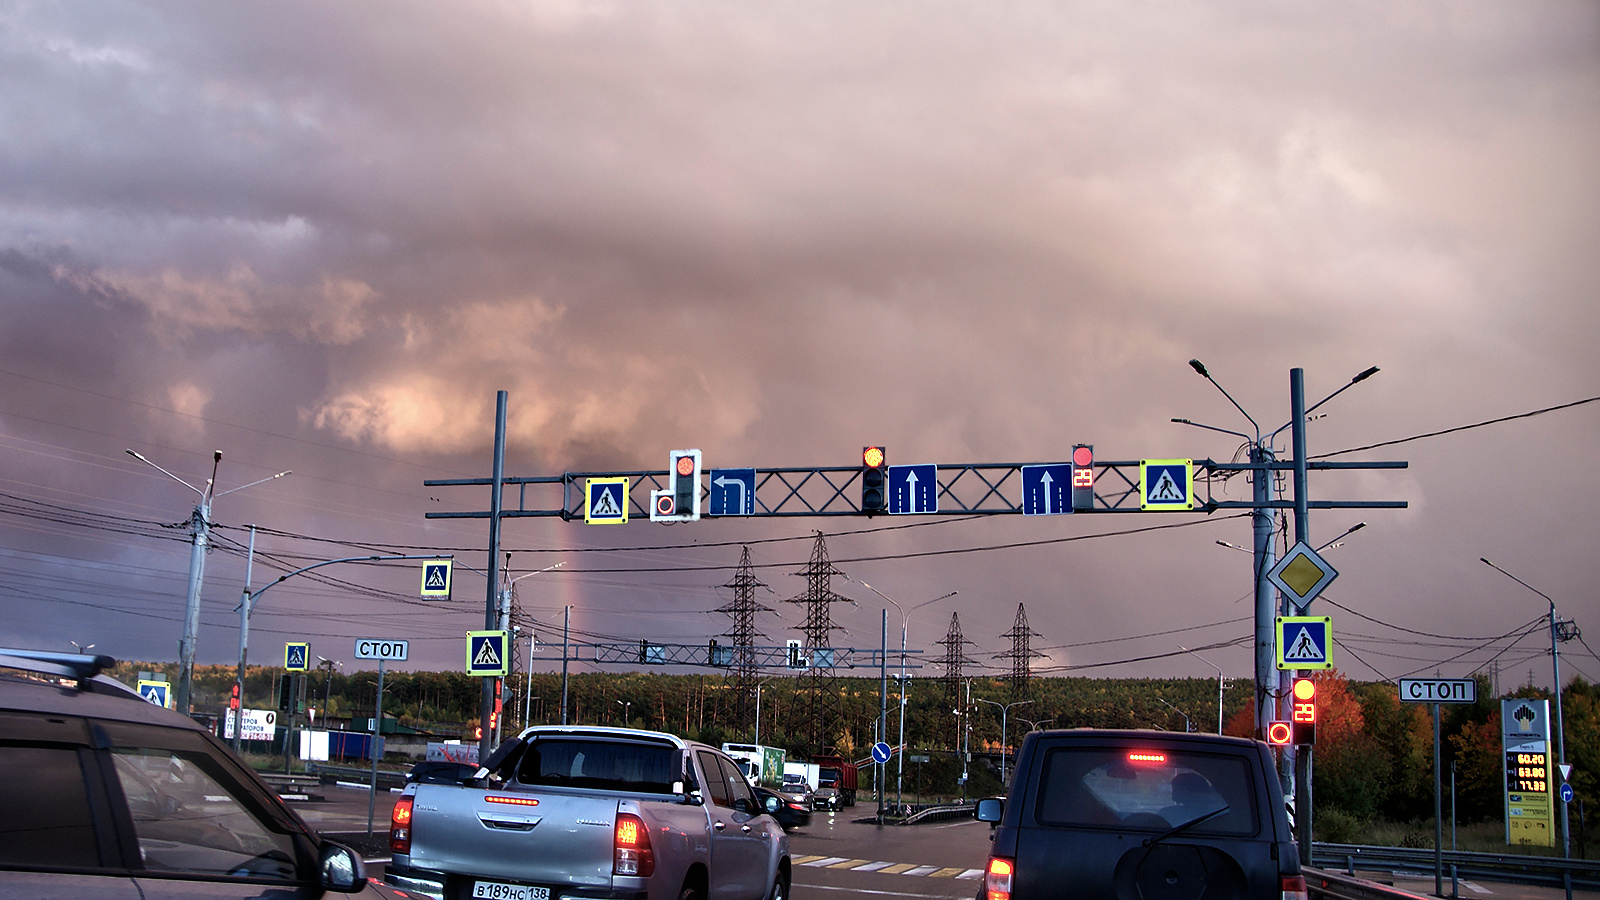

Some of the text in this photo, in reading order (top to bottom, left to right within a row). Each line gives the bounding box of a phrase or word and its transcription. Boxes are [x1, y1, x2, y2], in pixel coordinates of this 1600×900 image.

[1073, 468, 1093, 487] 29
[360, 641, 403, 657] СТОП
[1410, 681, 1465, 699] СТОП
[1294, 703, 1315, 722] 29
[1518, 754, 1545, 765] 60.20
[1518, 767, 1546, 778] 63.80
